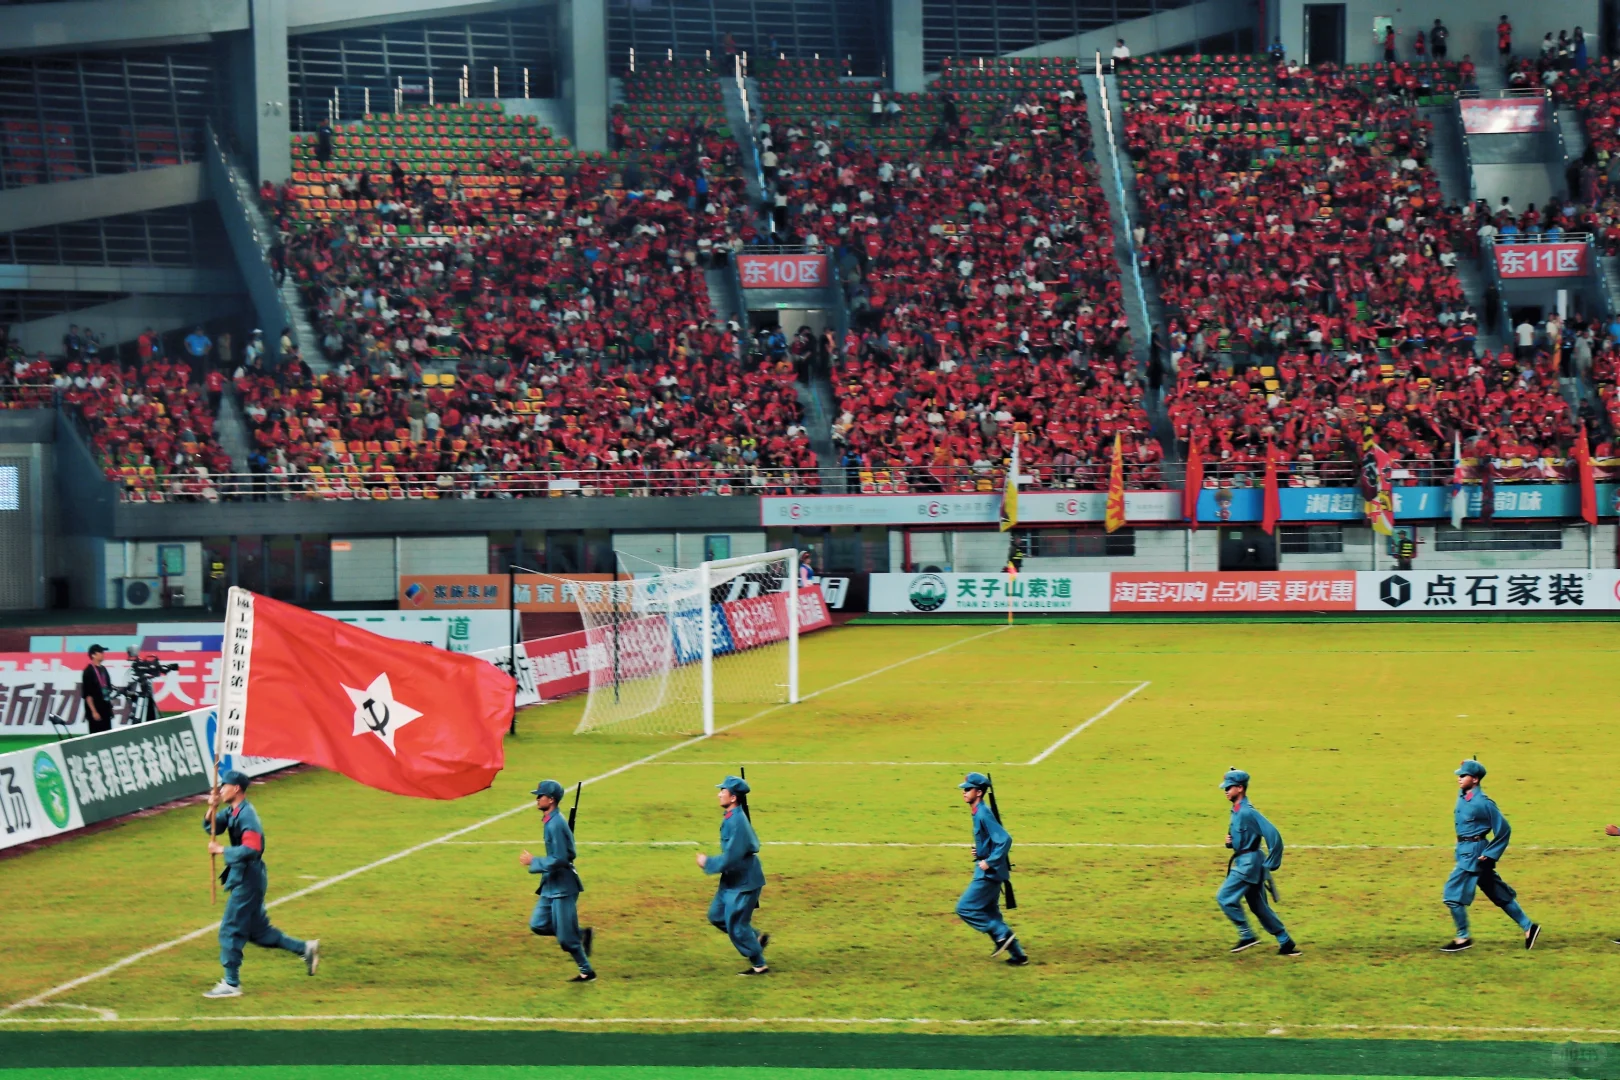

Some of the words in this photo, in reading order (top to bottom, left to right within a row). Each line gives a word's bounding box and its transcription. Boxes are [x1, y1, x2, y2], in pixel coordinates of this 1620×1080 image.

[743, 260, 821, 284] 东10区
[1500, 249, 1580, 273] 东11区
[957, 577, 1071, 598] 天子山索道
[1113, 581, 1207, 603] 淘宝闪购
[1212, 581, 1281, 602] 点外卖
[1284, 580, 1354, 602] 更优惠
[1423, 574, 1585, 606] 点石家装
[1022, 600, 1072, 608] CABLEWAY
